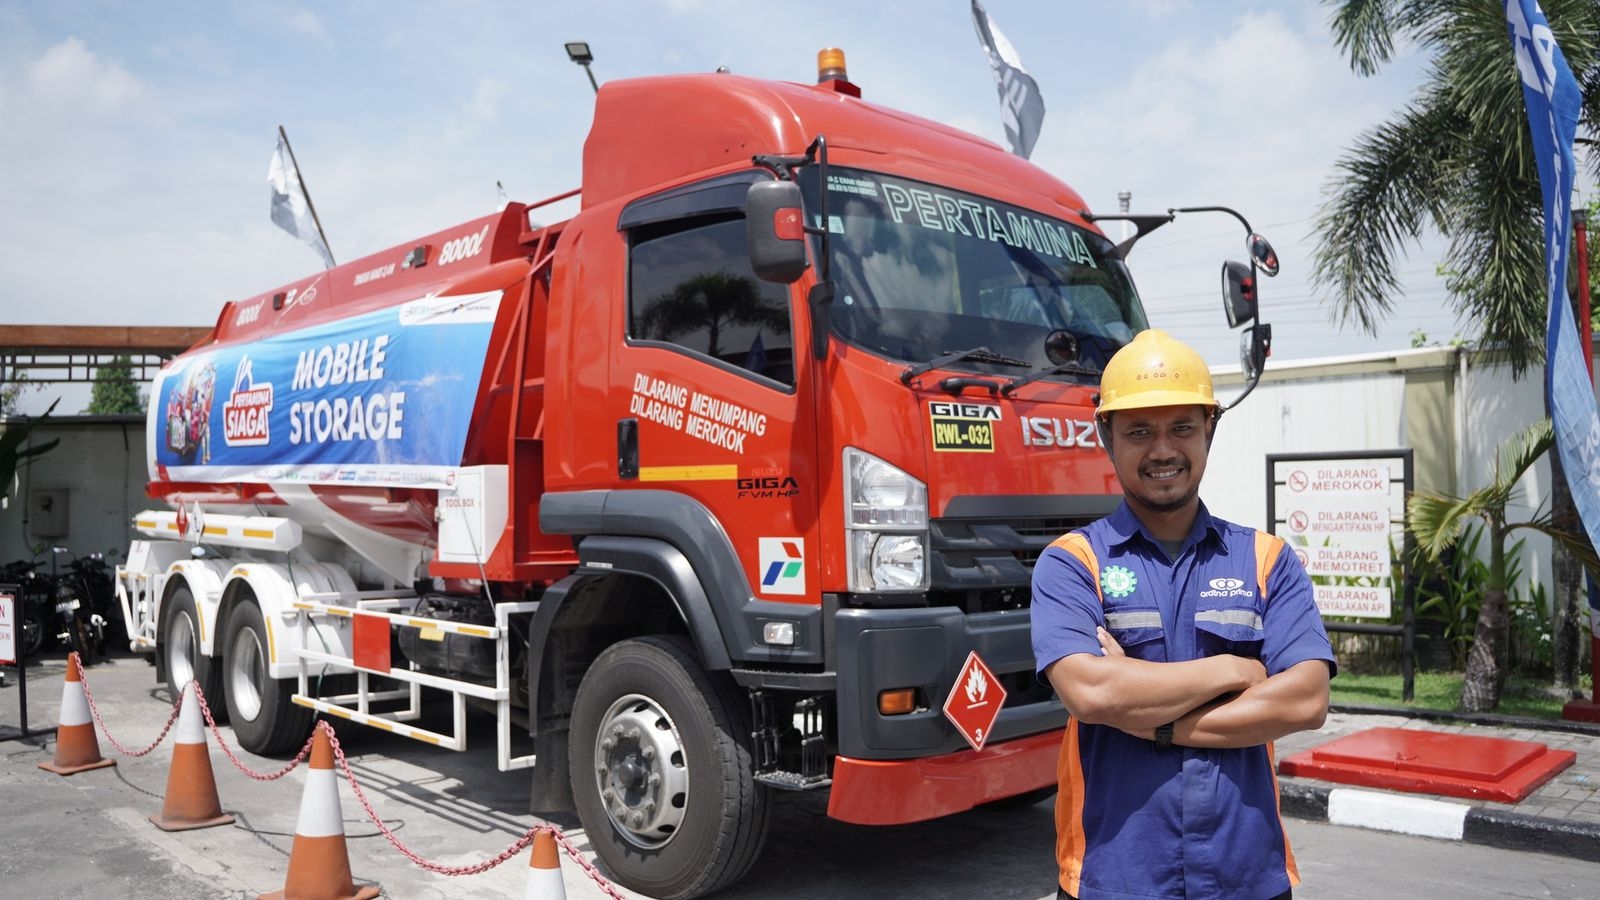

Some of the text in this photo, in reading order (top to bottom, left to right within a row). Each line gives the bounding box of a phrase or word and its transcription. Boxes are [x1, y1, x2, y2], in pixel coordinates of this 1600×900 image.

[881, 183, 1097, 269] PERTAMINA
[291, 335, 390, 391] MOBILE
[633, 373, 767, 436] DILARANG MENUMPANG
[289, 391, 406, 444] STORAGE
[931, 404, 1000, 419] GIGA
[226, 406, 267, 438] SIAGA
[630, 394, 746, 454] DILARANG MEROKOK
[935, 423, 991, 446] RWL-032
[1318, 469, 1378, 480] DILARANG
[737, 477, 799, 490] GIGA
[1312, 480, 1383, 491] MEROKOK
[738, 489, 799, 499] FVM HP
[1318, 511, 1378, 521] DILARANG
[1312, 522, 1385, 532] MENGAKTIFKAN HP
[1318, 550, 1378, 560] DILARANG
[1312, 561, 1384, 572] MEMOTRET
[1230, 589, 1253, 598] prima
[1318, 590, 1378, 600] DILARANG
[1371, 603, 1385, 612] API
[975, 728, 983, 742] 3
